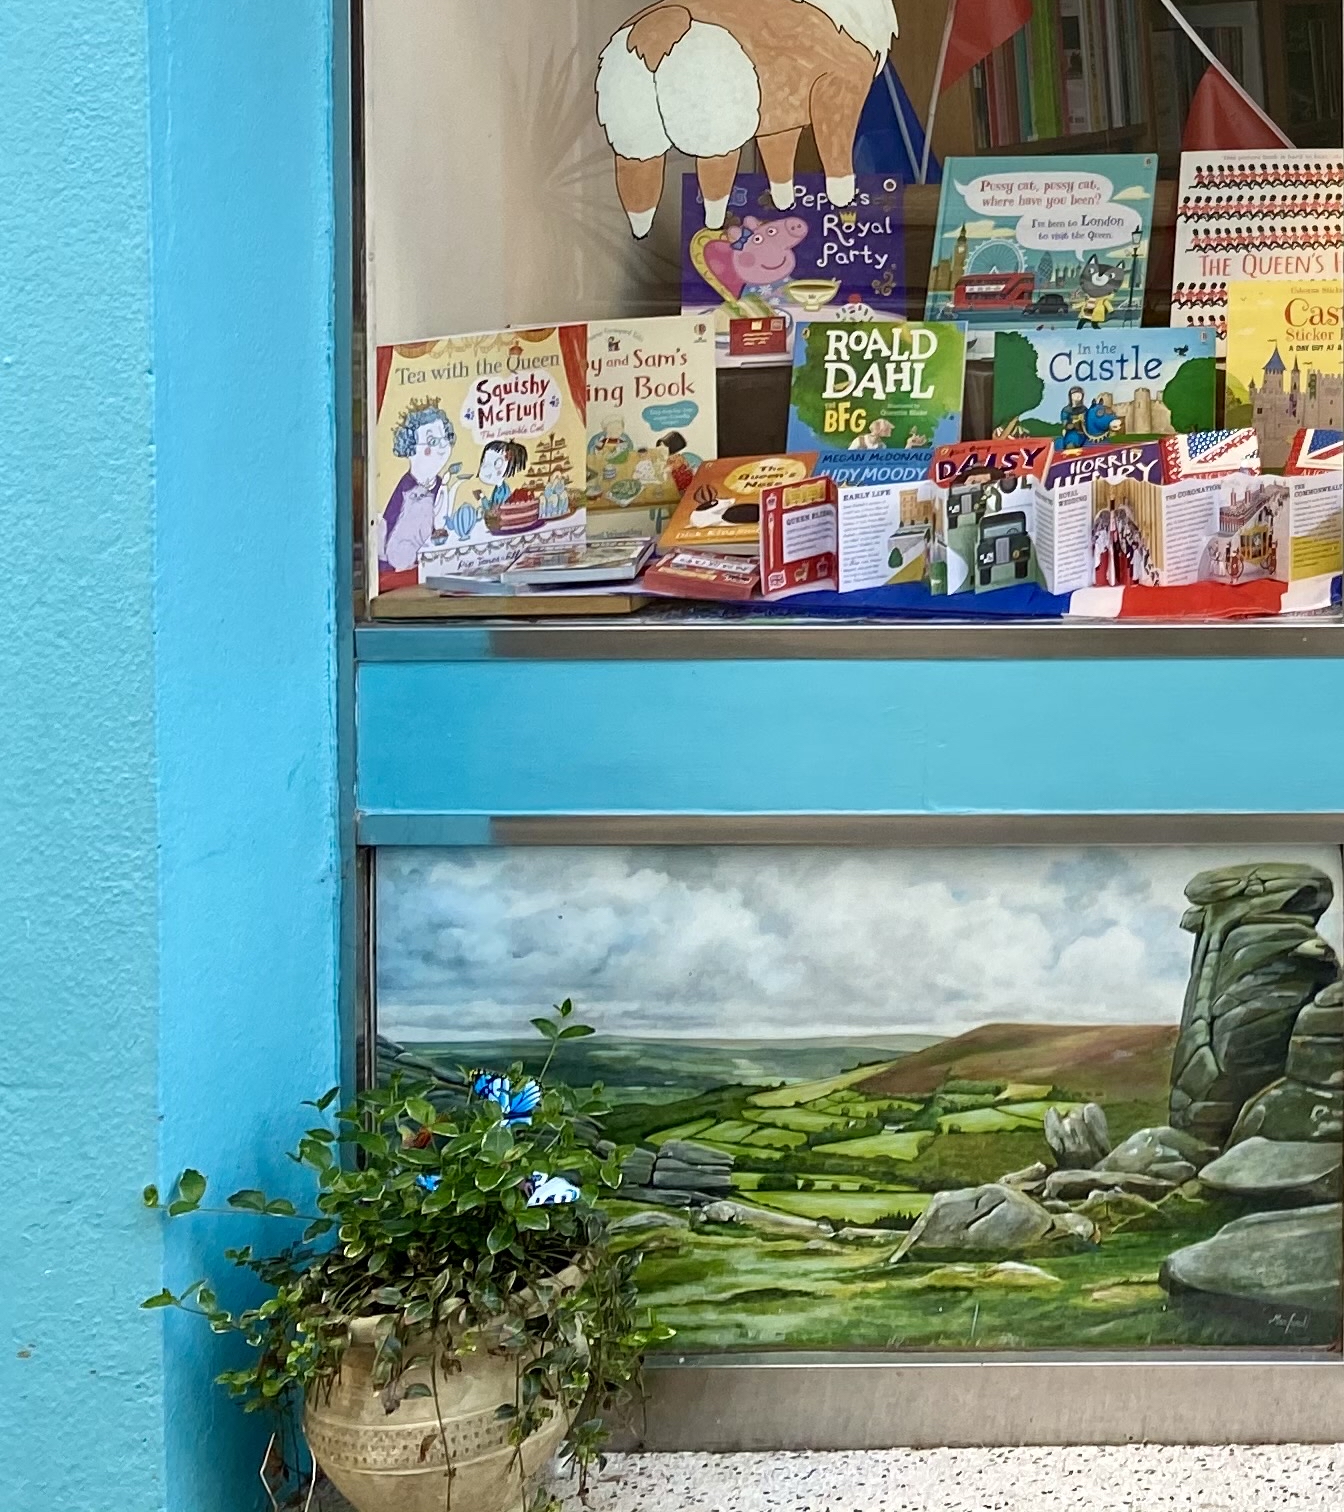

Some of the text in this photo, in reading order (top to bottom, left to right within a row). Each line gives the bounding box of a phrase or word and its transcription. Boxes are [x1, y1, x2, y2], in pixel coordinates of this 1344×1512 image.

[790, 185, 870, 211] Pep's
[980, 180, 1014, 194] Pussy
[1044, 181, 1074, 194] pussy
[982, 194, 1102, 209] where have you been?
[823, 214, 892, 246] Royal
[1081, 214, 1124, 227] London
[816, 242, 888, 269] Party
[1198, 255, 1232, 276] THE
[1242, 253, 1324, 278] QUEEN'S
[1285, 297, 1343, 327] Cas
[823, 328, 938, 361] ROALD
[1077, 341, 1117, 355] In the
[395, 354, 560, 385] Tea with the Queen
[606, 347, 688, 369] and Sam's
[1049, 345, 1163, 382] Castle
[476, 373, 551, 406] Squishy
[634, 372, 695, 400] Book
[822, 361, 935, 400] DAHL
[477, 399, 545, 429] McFluff
[823, 402, 867, 433] BFG
[822, 452, 933, 464] MEGAN McDONALD
[936, 447, 1046, 482] DAISY
[1070, 449, 1143, 474] HORRID
[861, 467, 928, 482] MOODY
[843, 489, 892, 501] EARLY LIFE
[1294, 483, 1343, 497] COMMONWEALT
